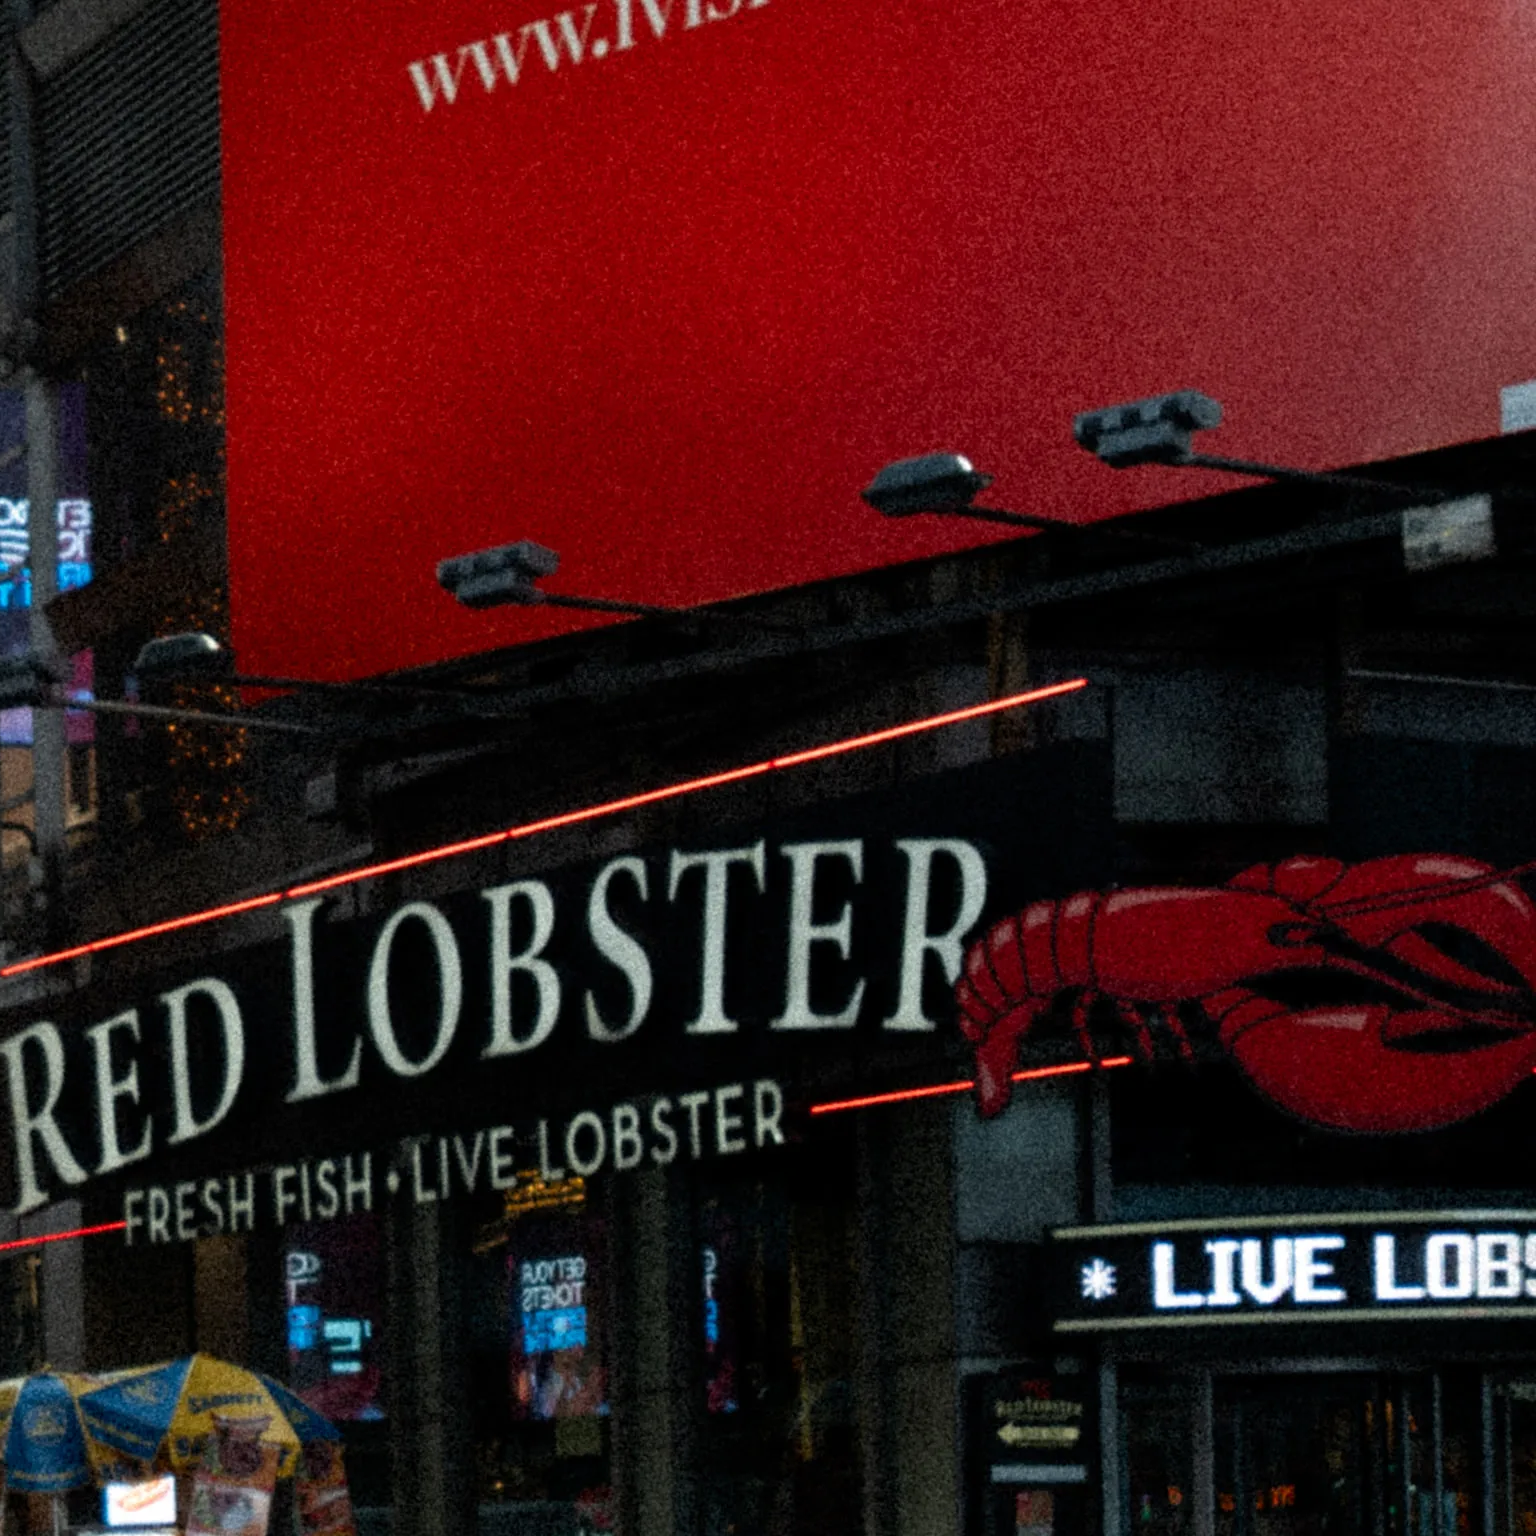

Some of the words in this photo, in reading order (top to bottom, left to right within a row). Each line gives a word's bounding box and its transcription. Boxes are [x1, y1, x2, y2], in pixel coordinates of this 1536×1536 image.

[282, 836, 988, 1102] LOBSTER
[123, 1171, 256, 1246] FRESH
[272, 1151, 372, 1227] FISH
[412, 1125, 516, 1204] LIVE
[540, 1078, 786, 1184] LOBSTER
[1152, 1234, 1347, 1310] LIVE
[1373, 1232, 1536, 1301] LOB
